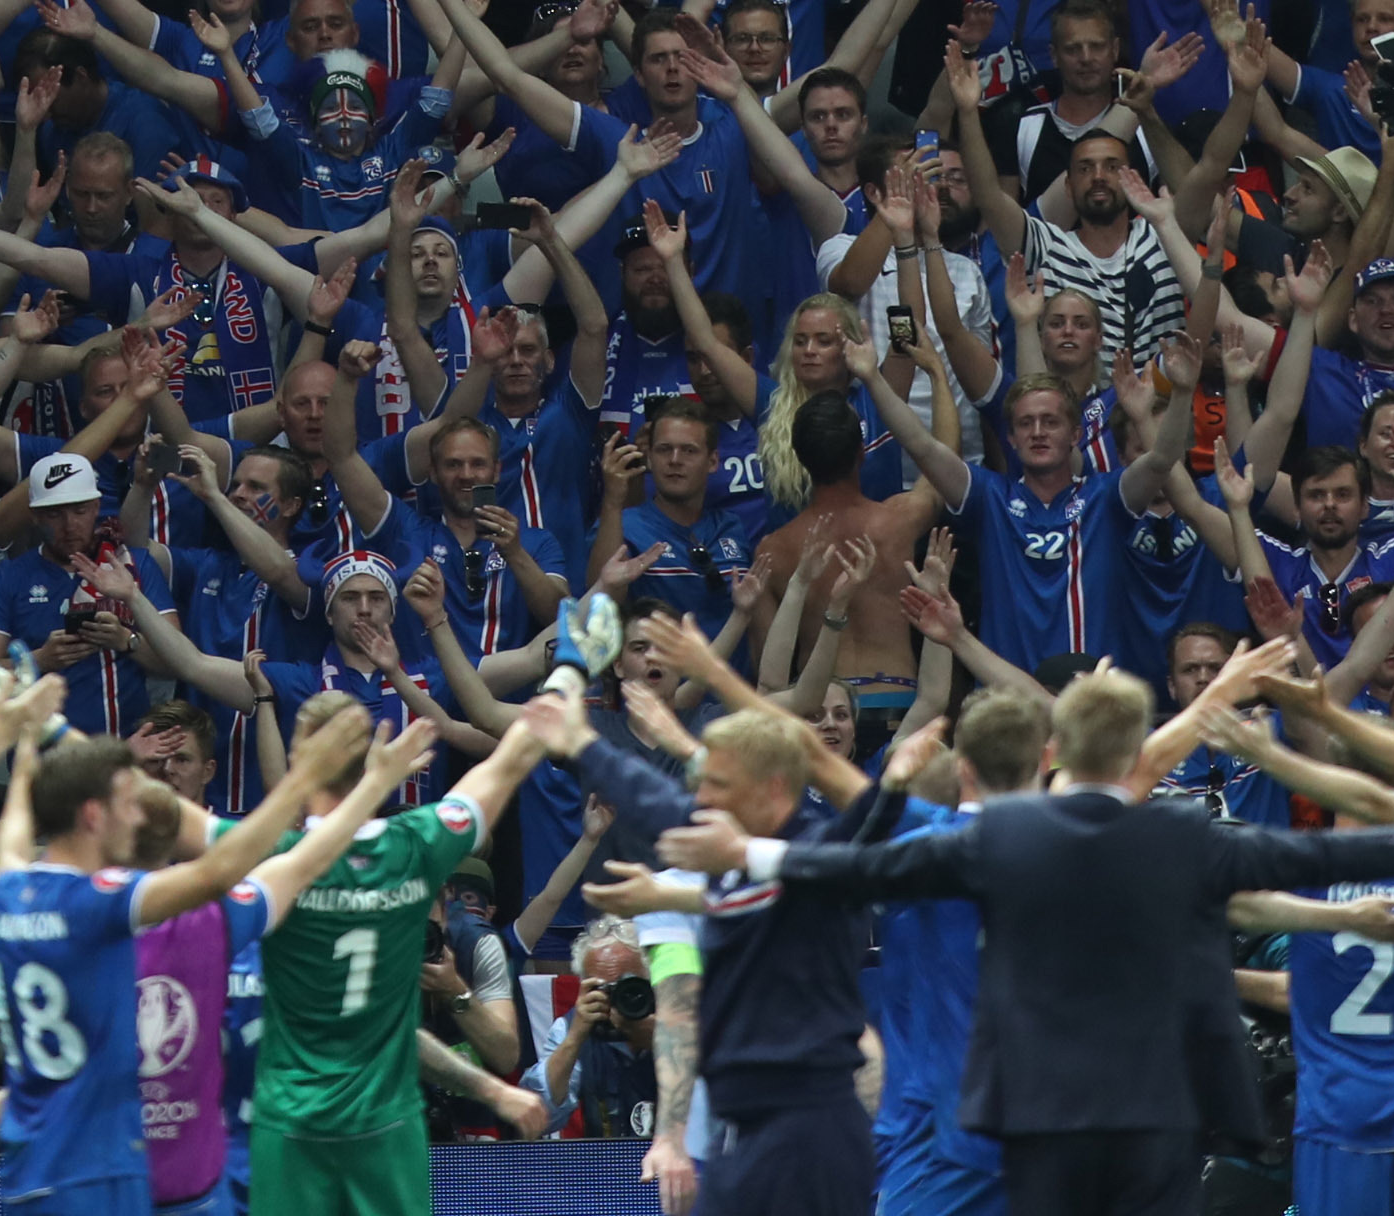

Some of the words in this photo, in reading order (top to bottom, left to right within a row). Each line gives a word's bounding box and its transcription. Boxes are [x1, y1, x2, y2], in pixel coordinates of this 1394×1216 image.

[49, 463, 73, 478] NIKE
[1023, 531, 1065, 560] 22
[336, 561, 394, 590] ISLAND
[332, 927, 379, 1018] 1
